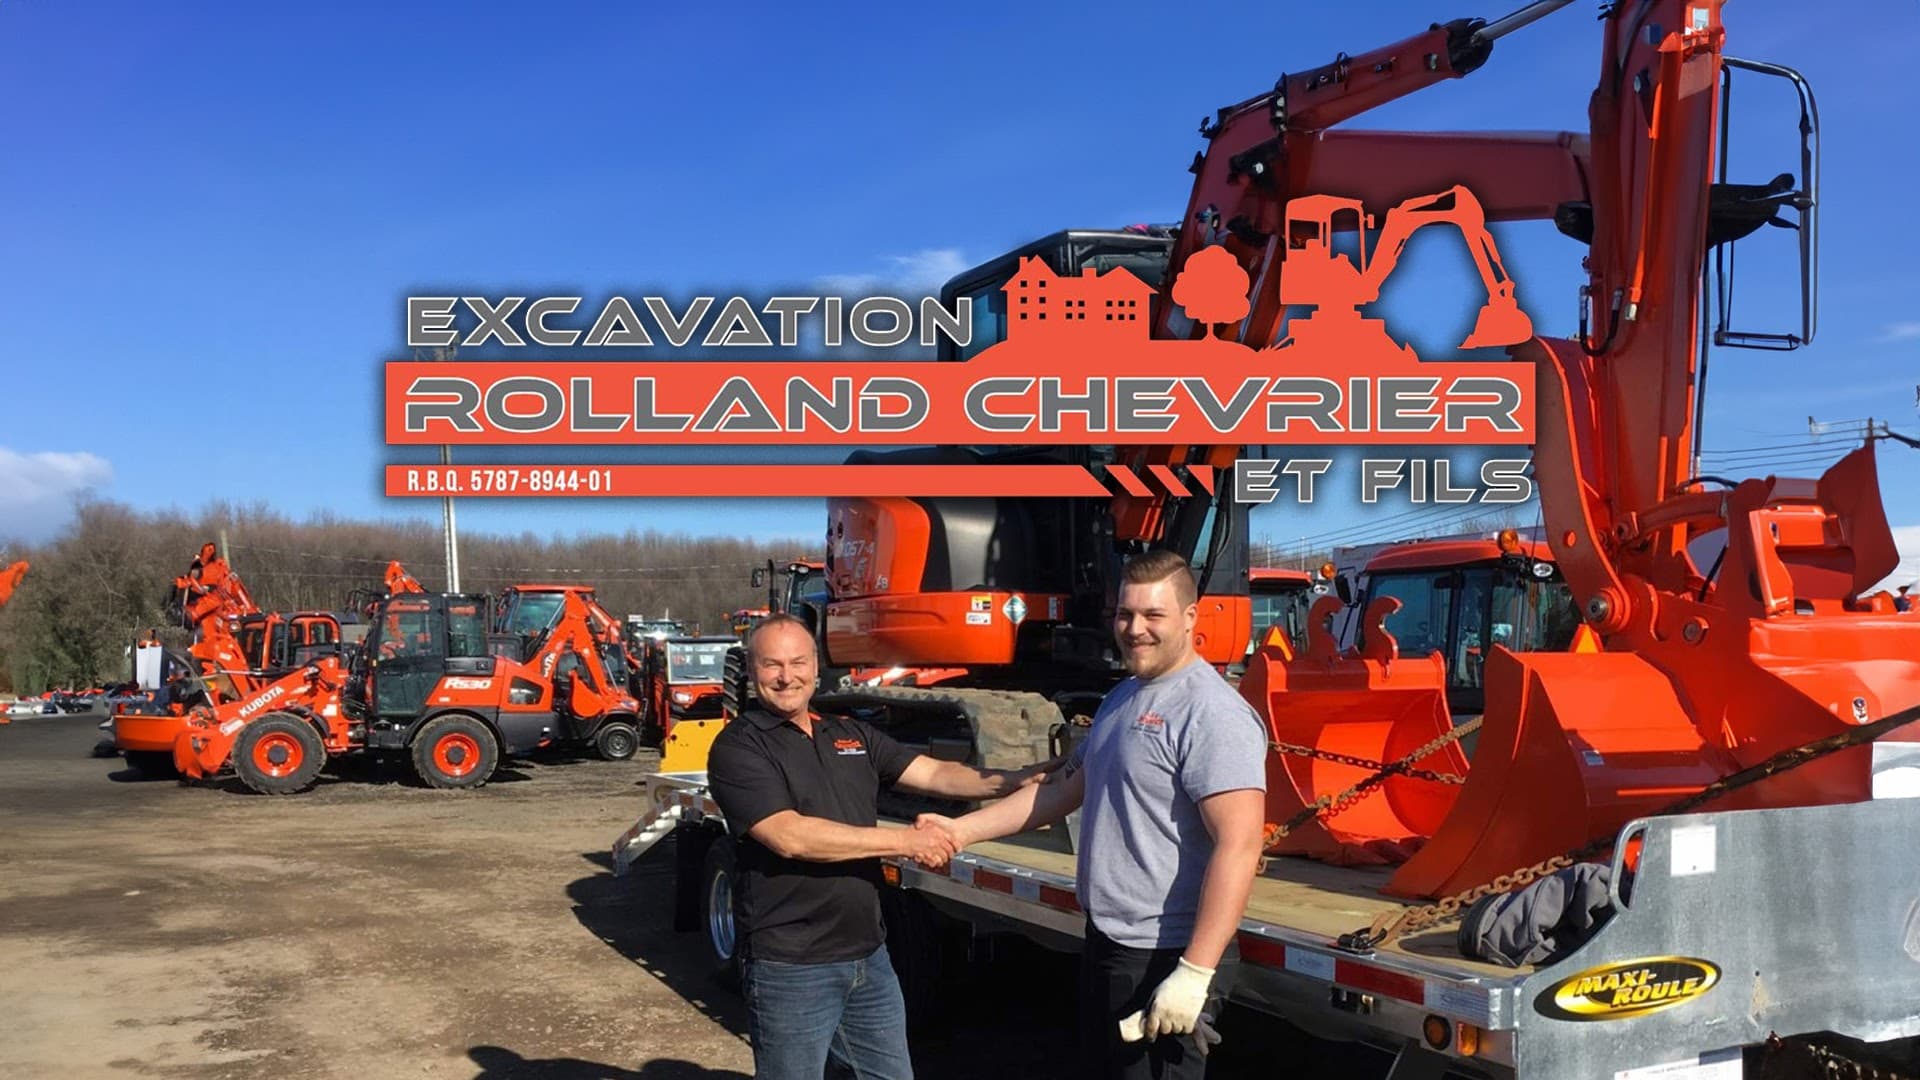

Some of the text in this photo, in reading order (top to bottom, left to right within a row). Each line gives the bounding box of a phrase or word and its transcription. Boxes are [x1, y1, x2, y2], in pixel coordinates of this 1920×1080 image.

[238, 685, 285, 718] KUBOTA
[1576, 969, 1657, 996] MAXI-
[1611, 977, 1703, 1007] ROULE
